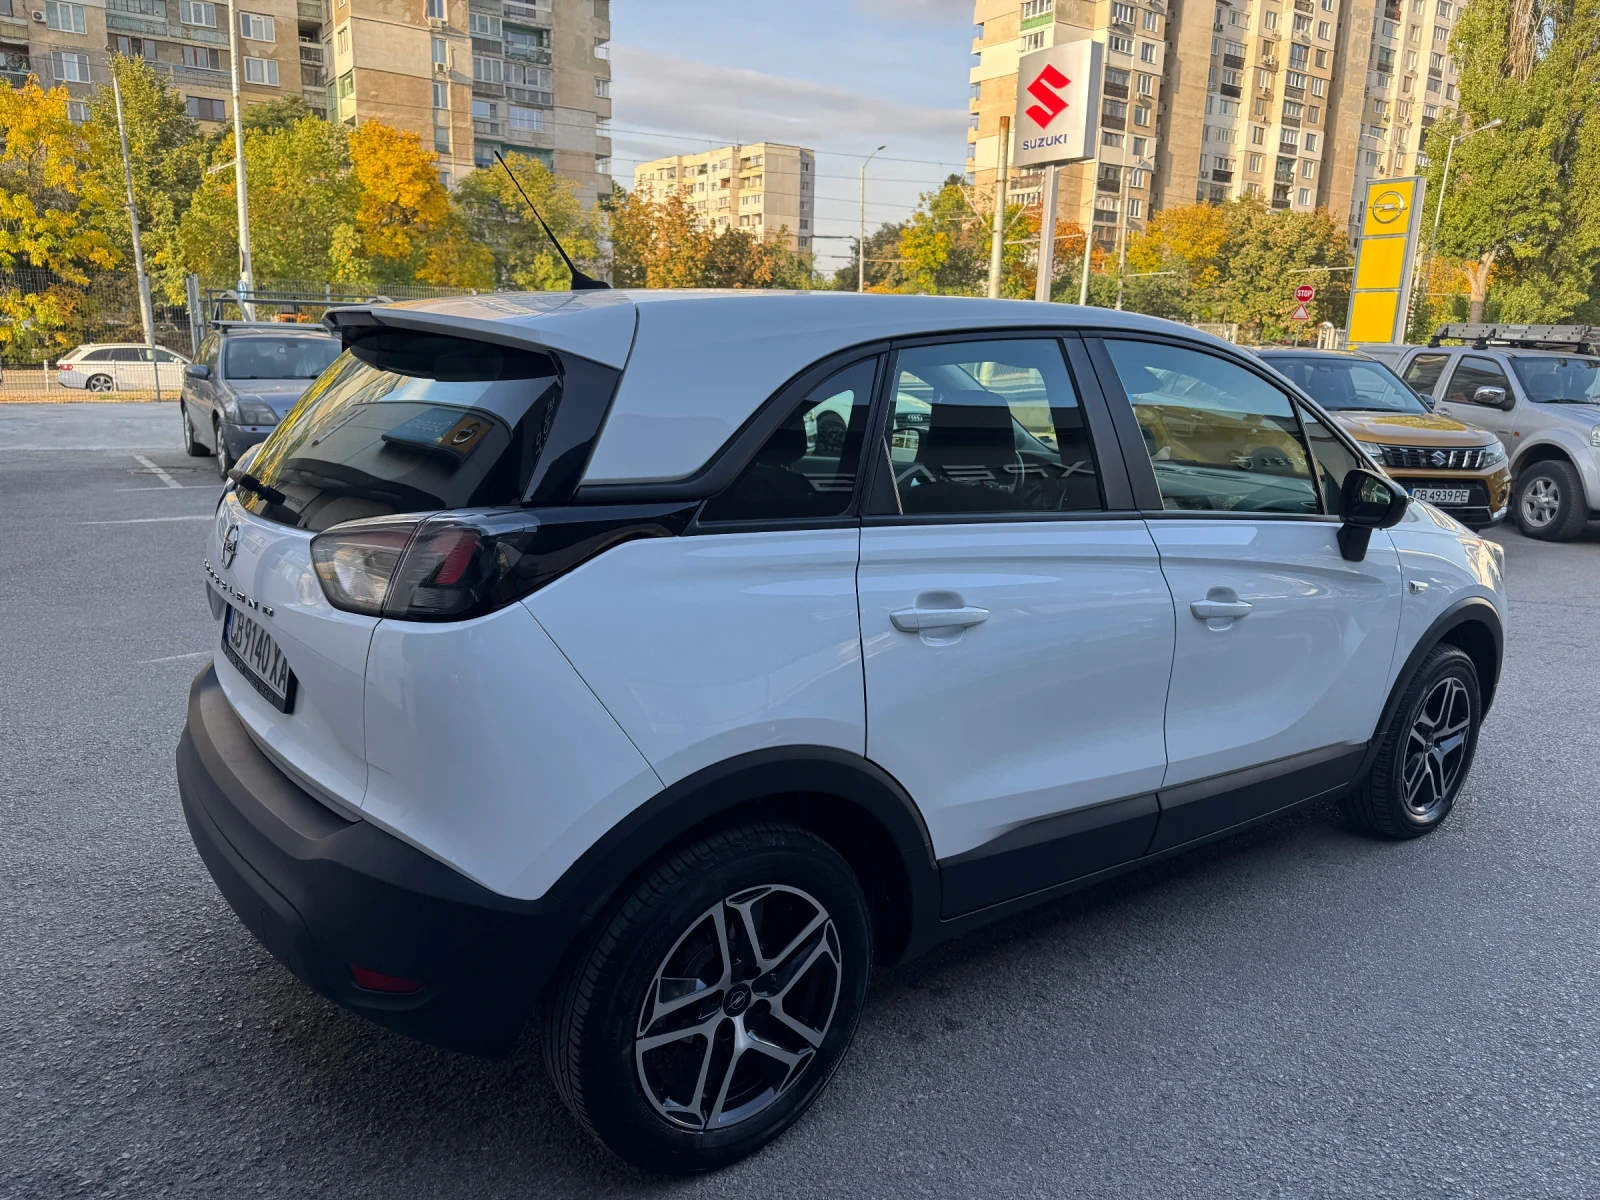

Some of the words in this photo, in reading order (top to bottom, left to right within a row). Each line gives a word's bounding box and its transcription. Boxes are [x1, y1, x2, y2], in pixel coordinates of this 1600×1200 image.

[1022, 133, 1068, 151] SUZUKI
[1413, 489, 1427, 500] CB
[1429, 490, 1453, 501] 4939
[1454, 490, 1468, 501] PE
[244, 618, 271, 675] 9140
[269, 643, 289, 695] XA
